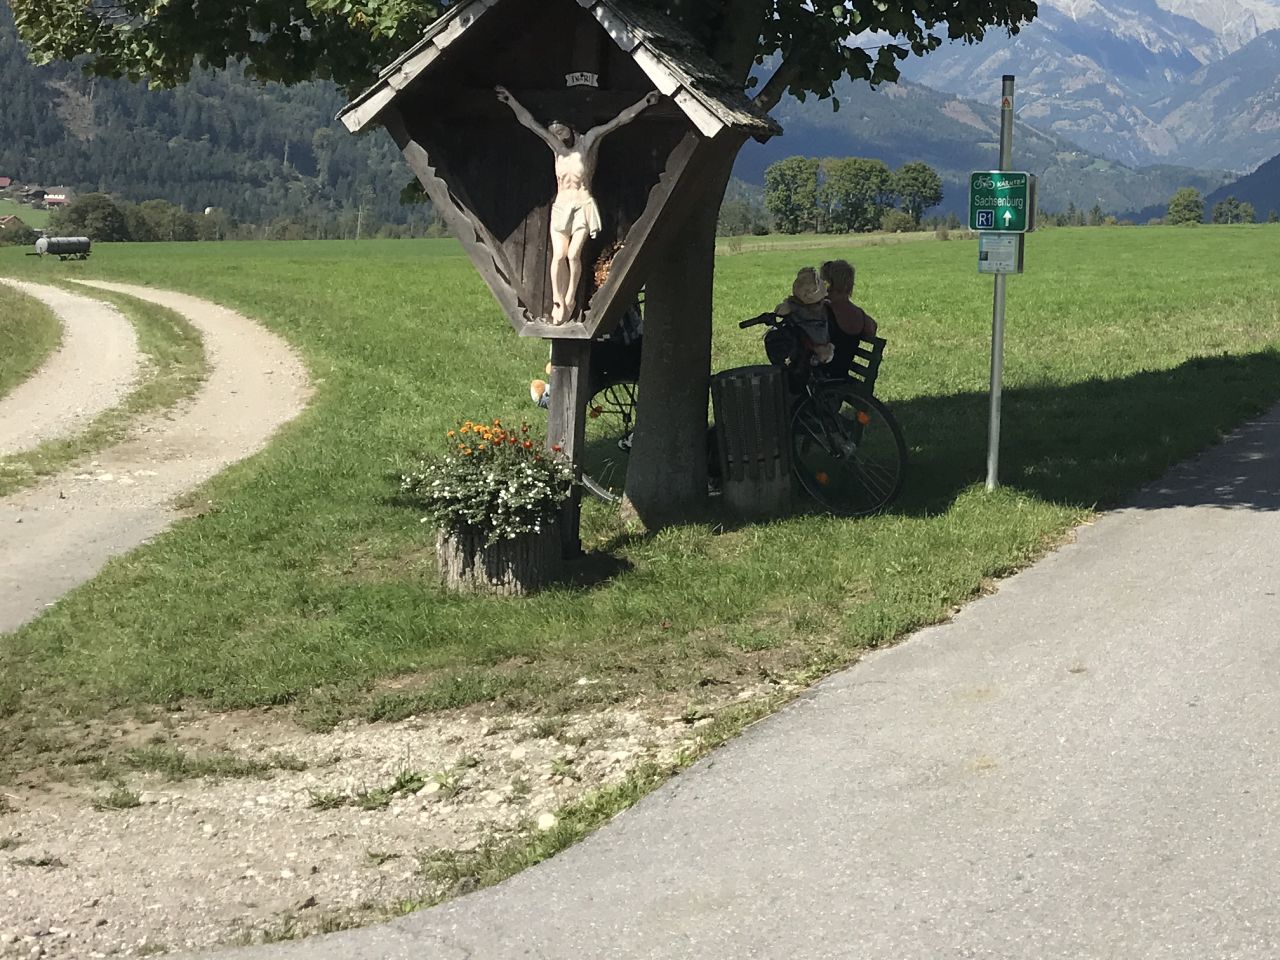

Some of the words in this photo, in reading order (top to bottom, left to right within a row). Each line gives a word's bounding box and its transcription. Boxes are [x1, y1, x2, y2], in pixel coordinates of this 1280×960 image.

[571, 74, 591, 83] INRI
[974, 195, 1024, 209] Sachsenburg
[978, 213, 992, 225] R1
